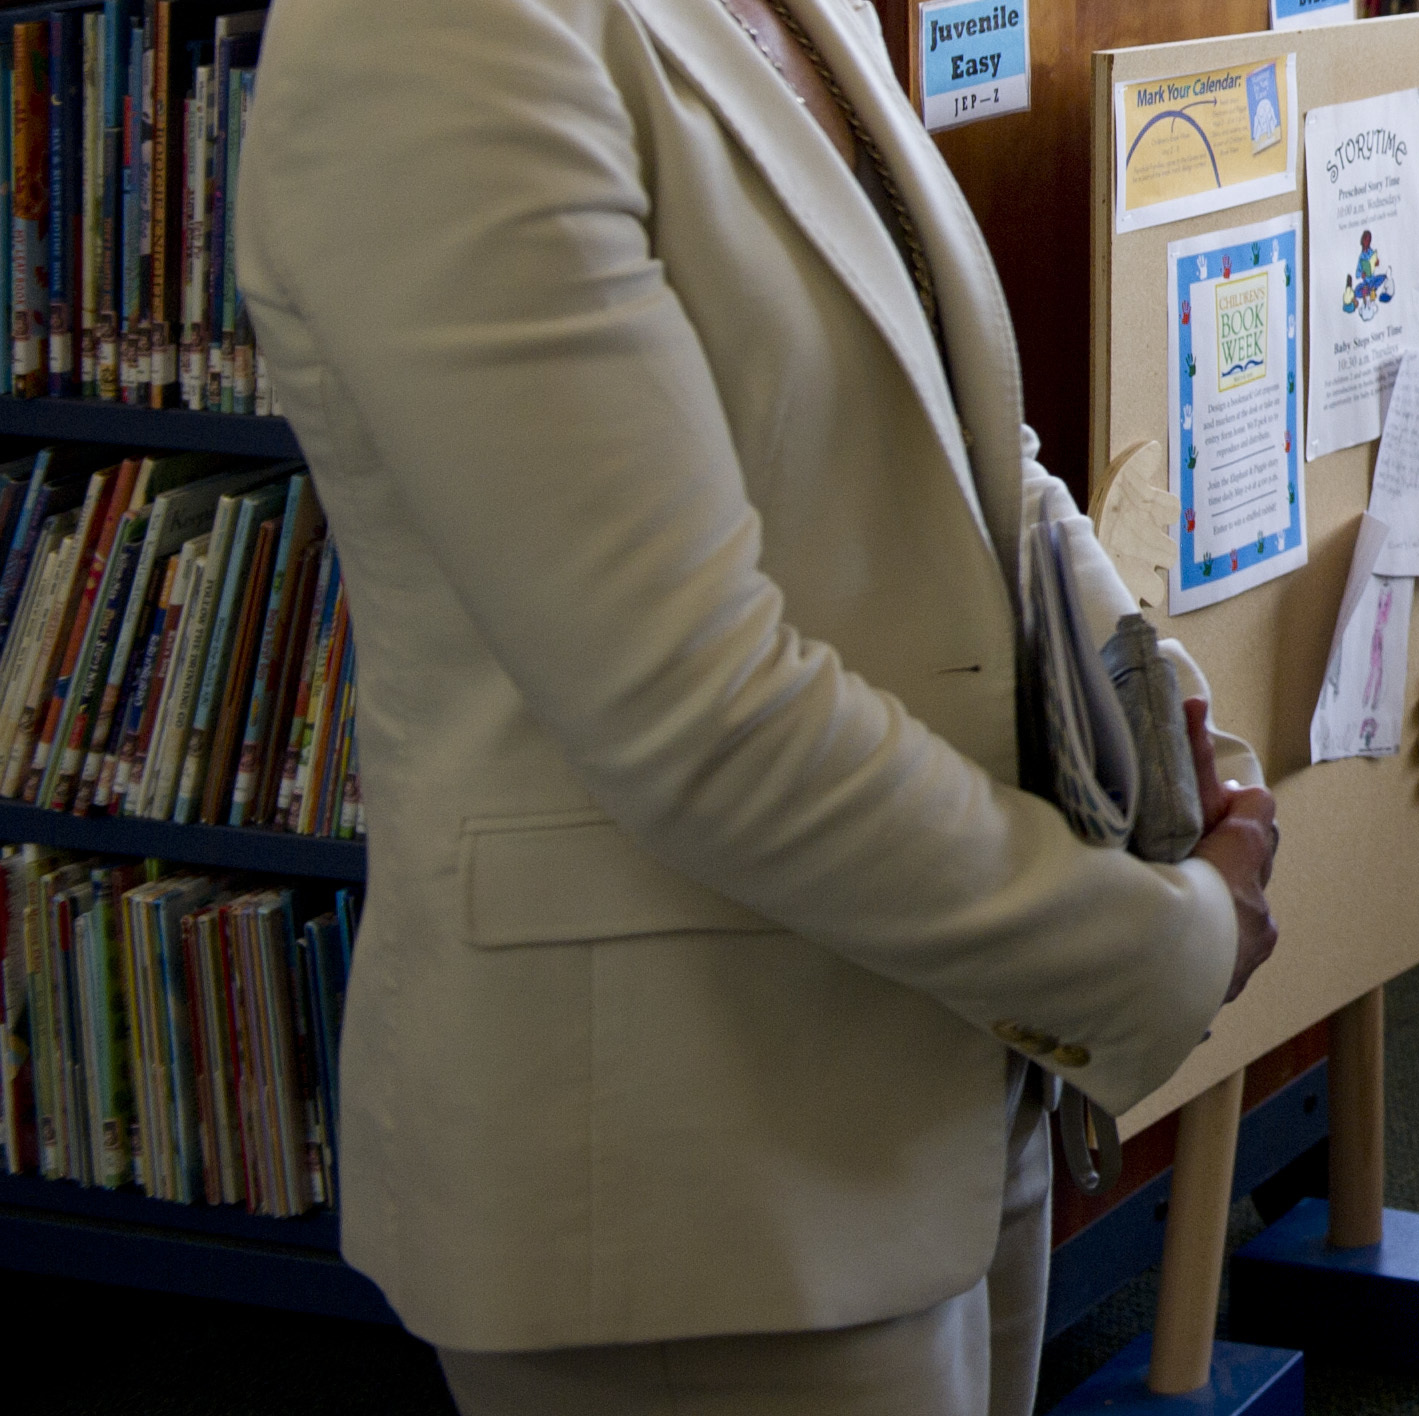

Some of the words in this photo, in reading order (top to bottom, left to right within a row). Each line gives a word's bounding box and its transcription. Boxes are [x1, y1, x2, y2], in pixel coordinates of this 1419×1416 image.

[930, 5, 1020, 52] Juvenile
[951, 52, 1002, 81] Easy
[1137, 86, 1166, 108] Mark
[1167, 82, 1191, 102] Your
[1192, 72, 1242, 97] Calendar:
[1326, 128, 1408, 184] STORYTIME
[1338, 182, 1366, 200] Preschool
[1368, 178, 1382, 195] Story
[1385, 172, 1400, 187] Time
[1367, 190, 1401, 212] Wednesdays
[14, 277, 25, 306] BOOK
[51, 261, 62, 295] BOOK
[1219, 287, 1266, 312] CHILDREN'S
[1221, 302, 1264, 339] BOOK
[1221, 330, 1264, 365] WEEK
[1333, 338, 1350, 357] Baby
[1353, 332, 1369, 351] Steps
[1370, 328, 1384, 345] Story
[1386, 321, 1402, 338] Time
[195, 578, 214, 629] FOLLOW
[190, 628, 204, 651] THE
[178, 652, 198, 710] DRINKING
